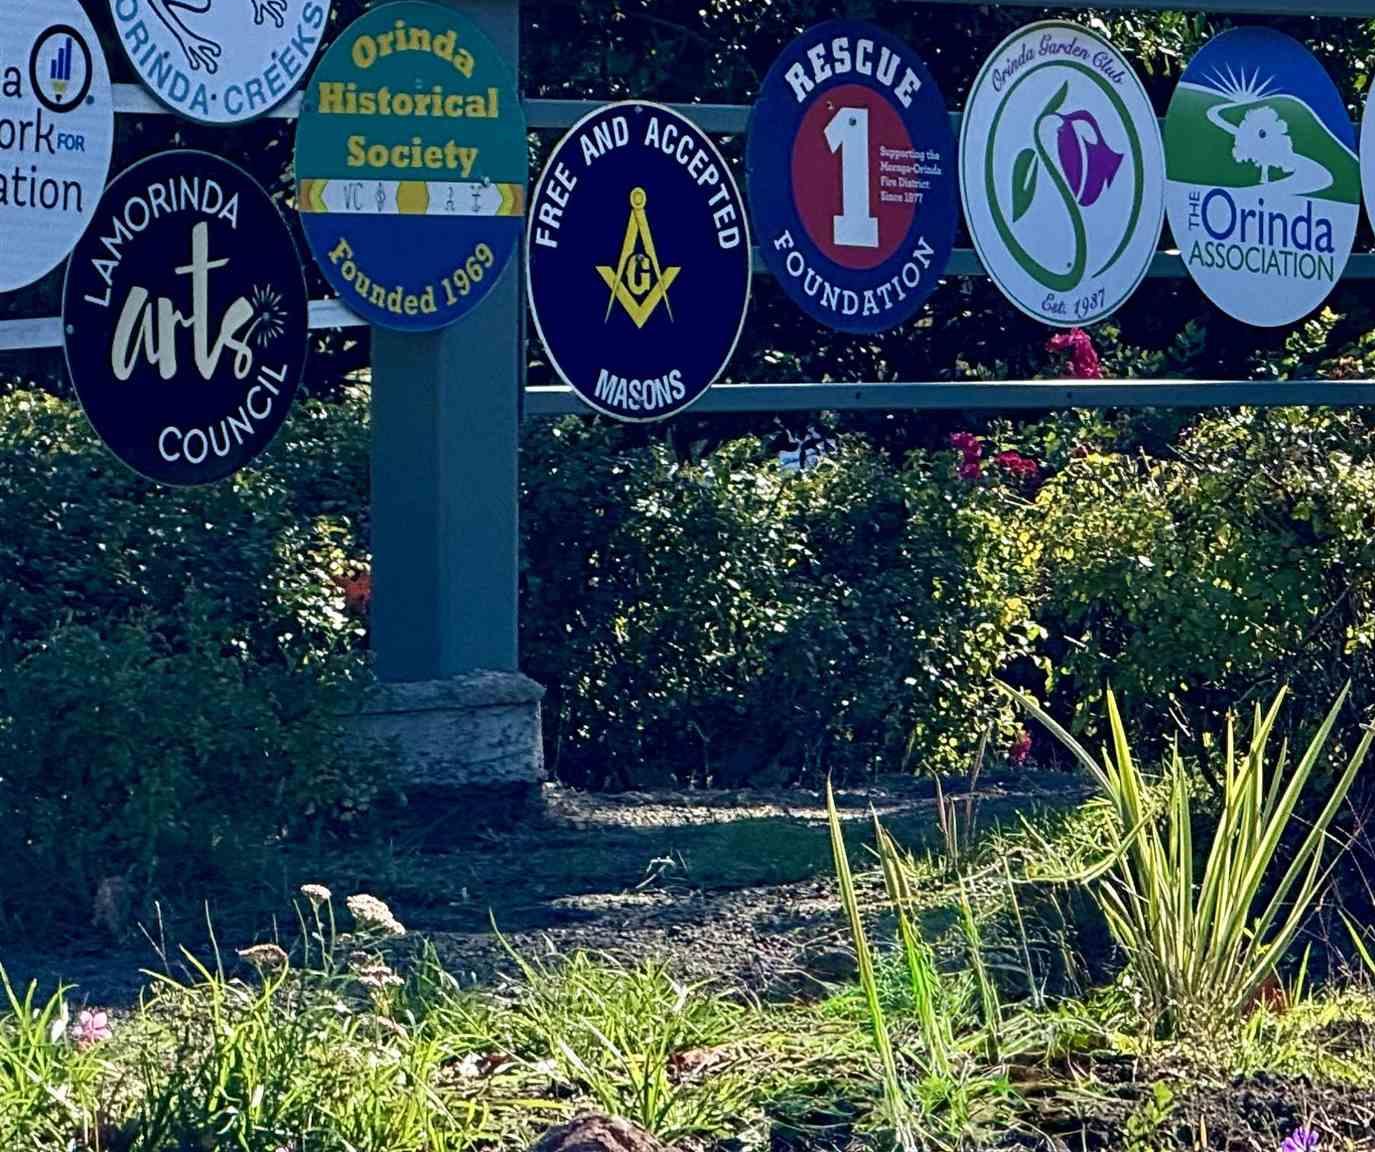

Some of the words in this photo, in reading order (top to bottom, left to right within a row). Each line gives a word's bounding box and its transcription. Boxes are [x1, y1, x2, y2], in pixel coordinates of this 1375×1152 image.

[223, 1, 324, 115] CREEKS
[352, 19, 476, 78] Orinda
[785, 37, 922, 108] RESCUE
[992, 43, 1034, 92] Orinda
[1038, 34, 1090, 60] Garden
[1092, 51, 1126, 84] Club
[319, 82, 498, 118] Historical
[57, 133, 85, 153] FOR
[347, 135, 478, 177] Society
[535, 162, 577, 249] FREE
[579, 116, 630, 166] AND
[645, 117, 740, 249] ACCEPTED
[824, 107, 879, 248] 1
[84, 176, 239, 307] LAMORINDA
[1188, 191, 1200, 230] THE
[1201, 188, 1335, 253] Orinda
[328, 237, 437, 315] Founded
[441, 243, 494, 306] 1969
[627, 254, 651, 295] G
[774, 230, 935, 317] FOUNDATION
[1188, 239, 1335, 282] ASSOCIATION
[112, 221, 254, 380] arts
[159, 364, 288, 464] COUNCIL
[594, 369, 686, 410] MASONS
